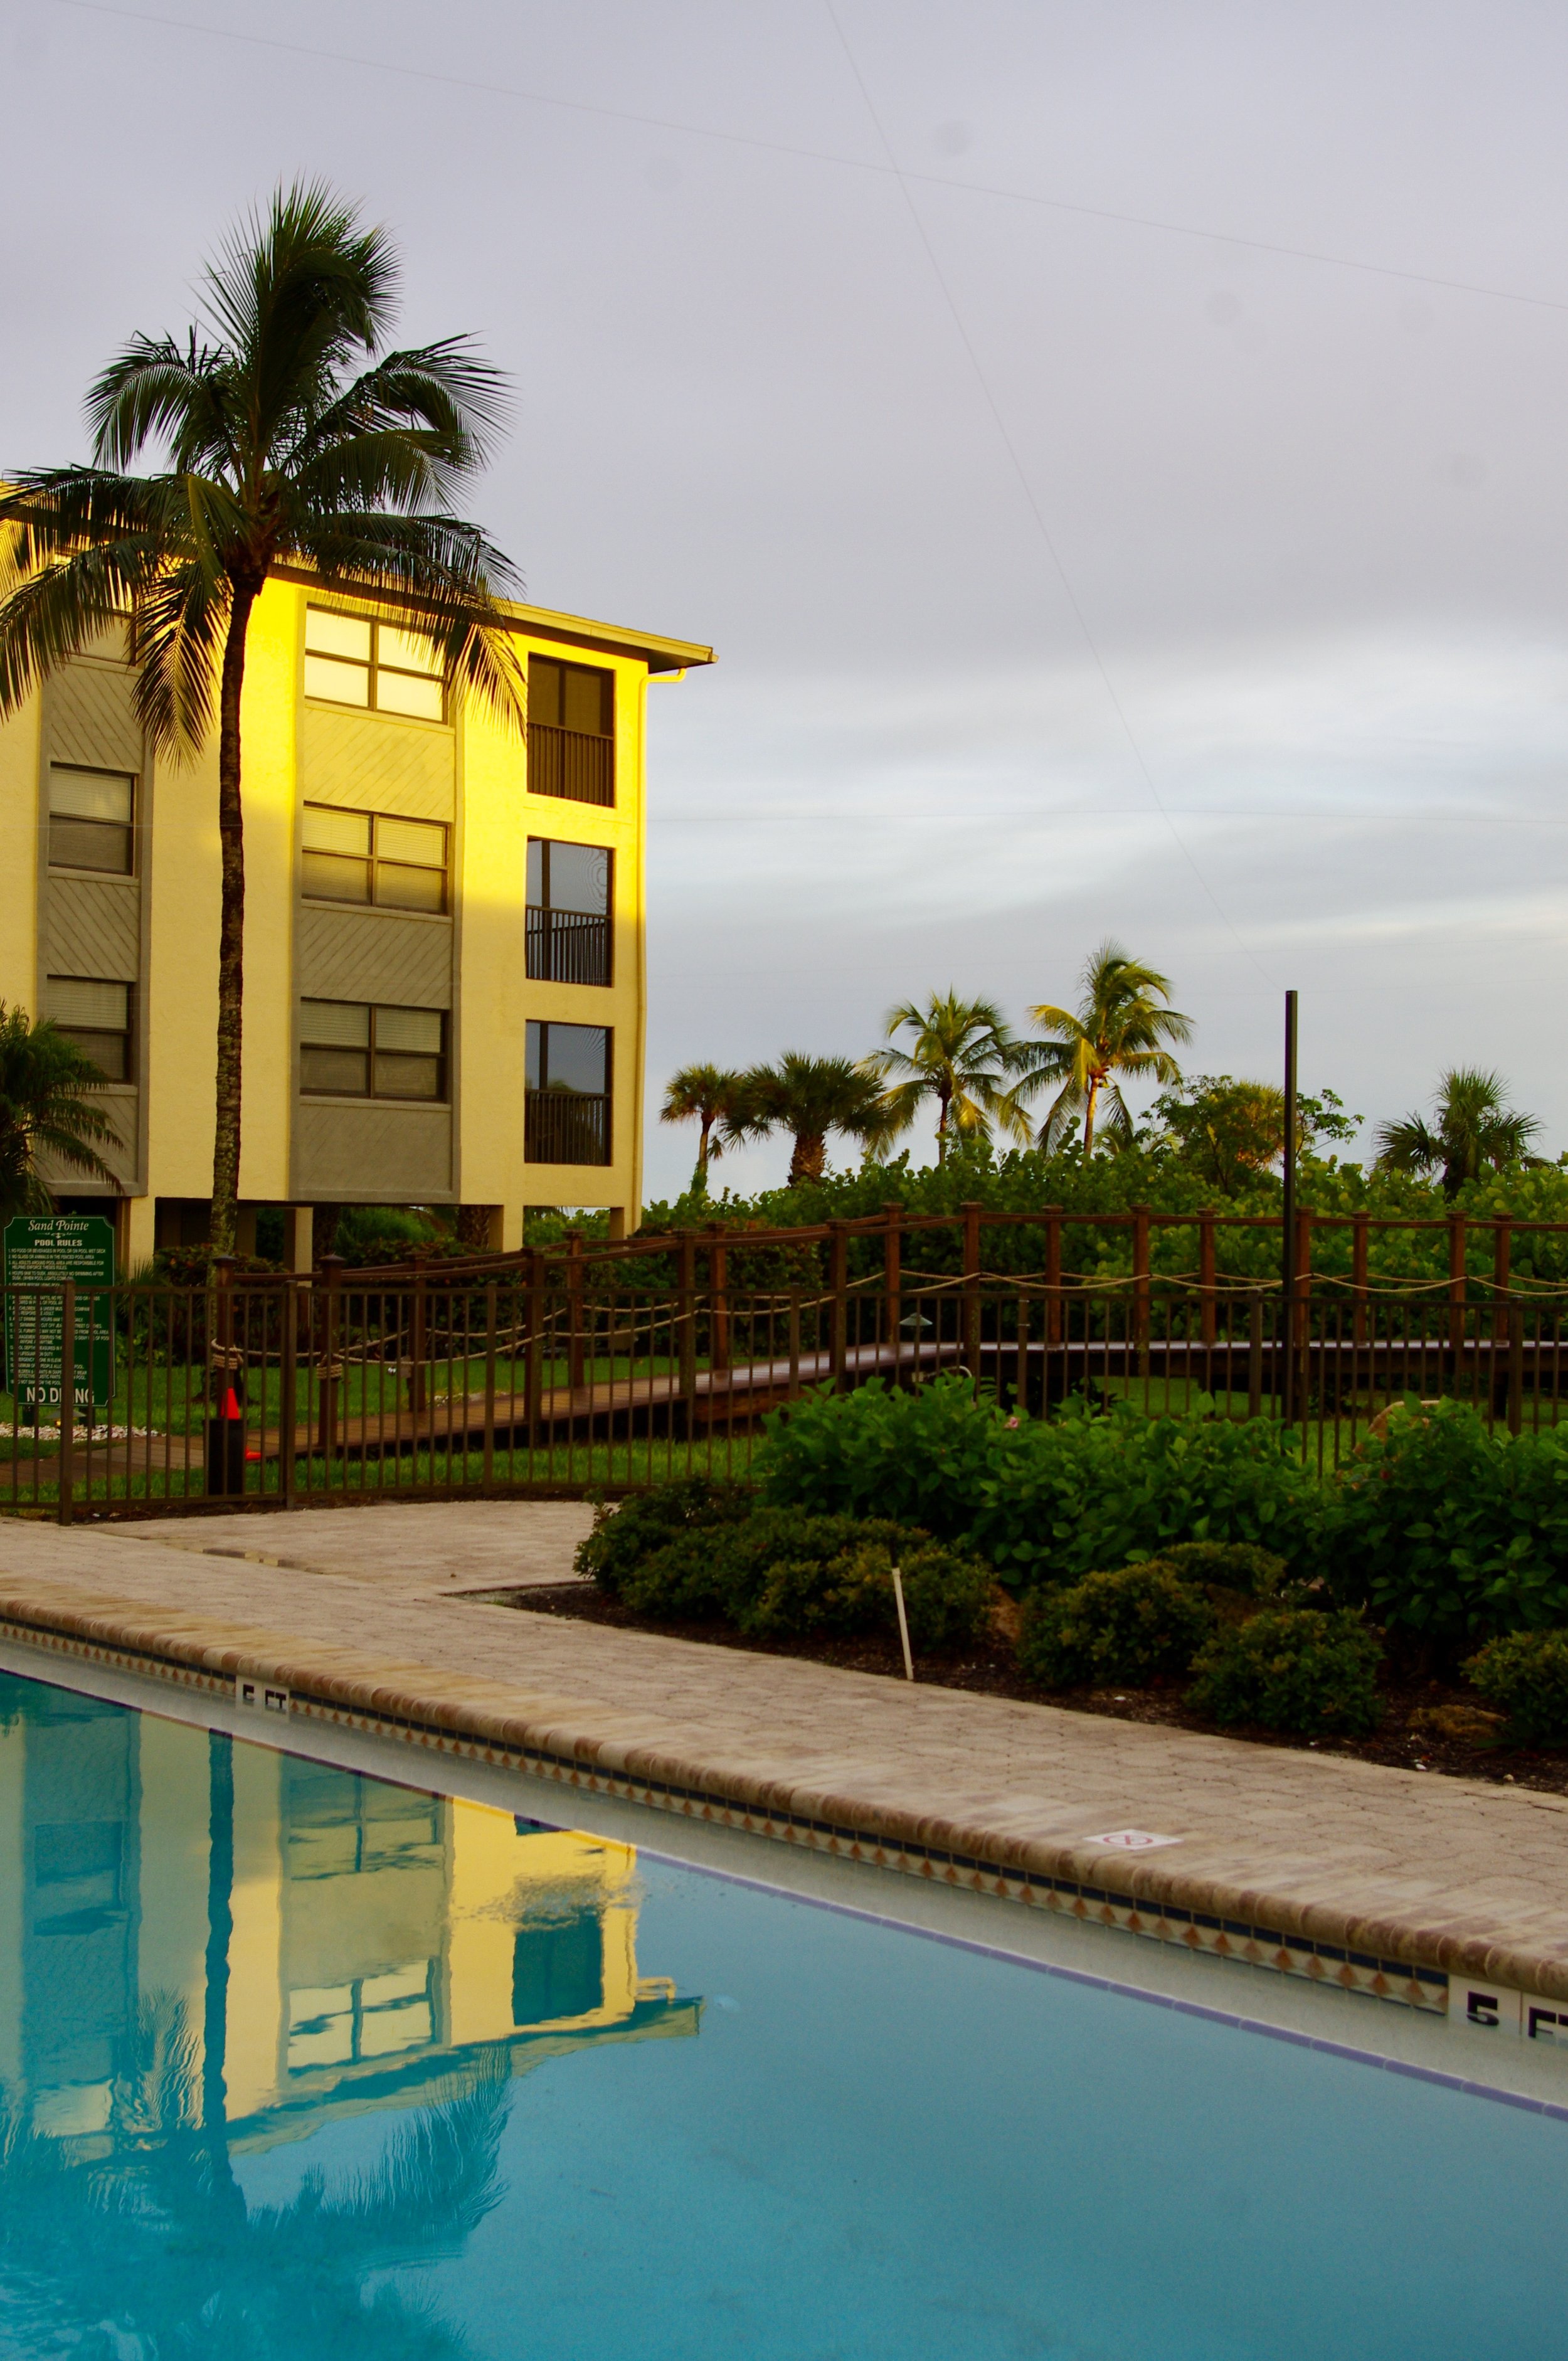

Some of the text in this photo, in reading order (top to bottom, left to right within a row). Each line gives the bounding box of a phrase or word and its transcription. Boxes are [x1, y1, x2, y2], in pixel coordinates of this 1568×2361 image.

[28, 1219, 89, 1231] Sand Pointe
[27, 1387, 94, 1404] NO DING
[1466, 1991, 1500, 2026] 5
